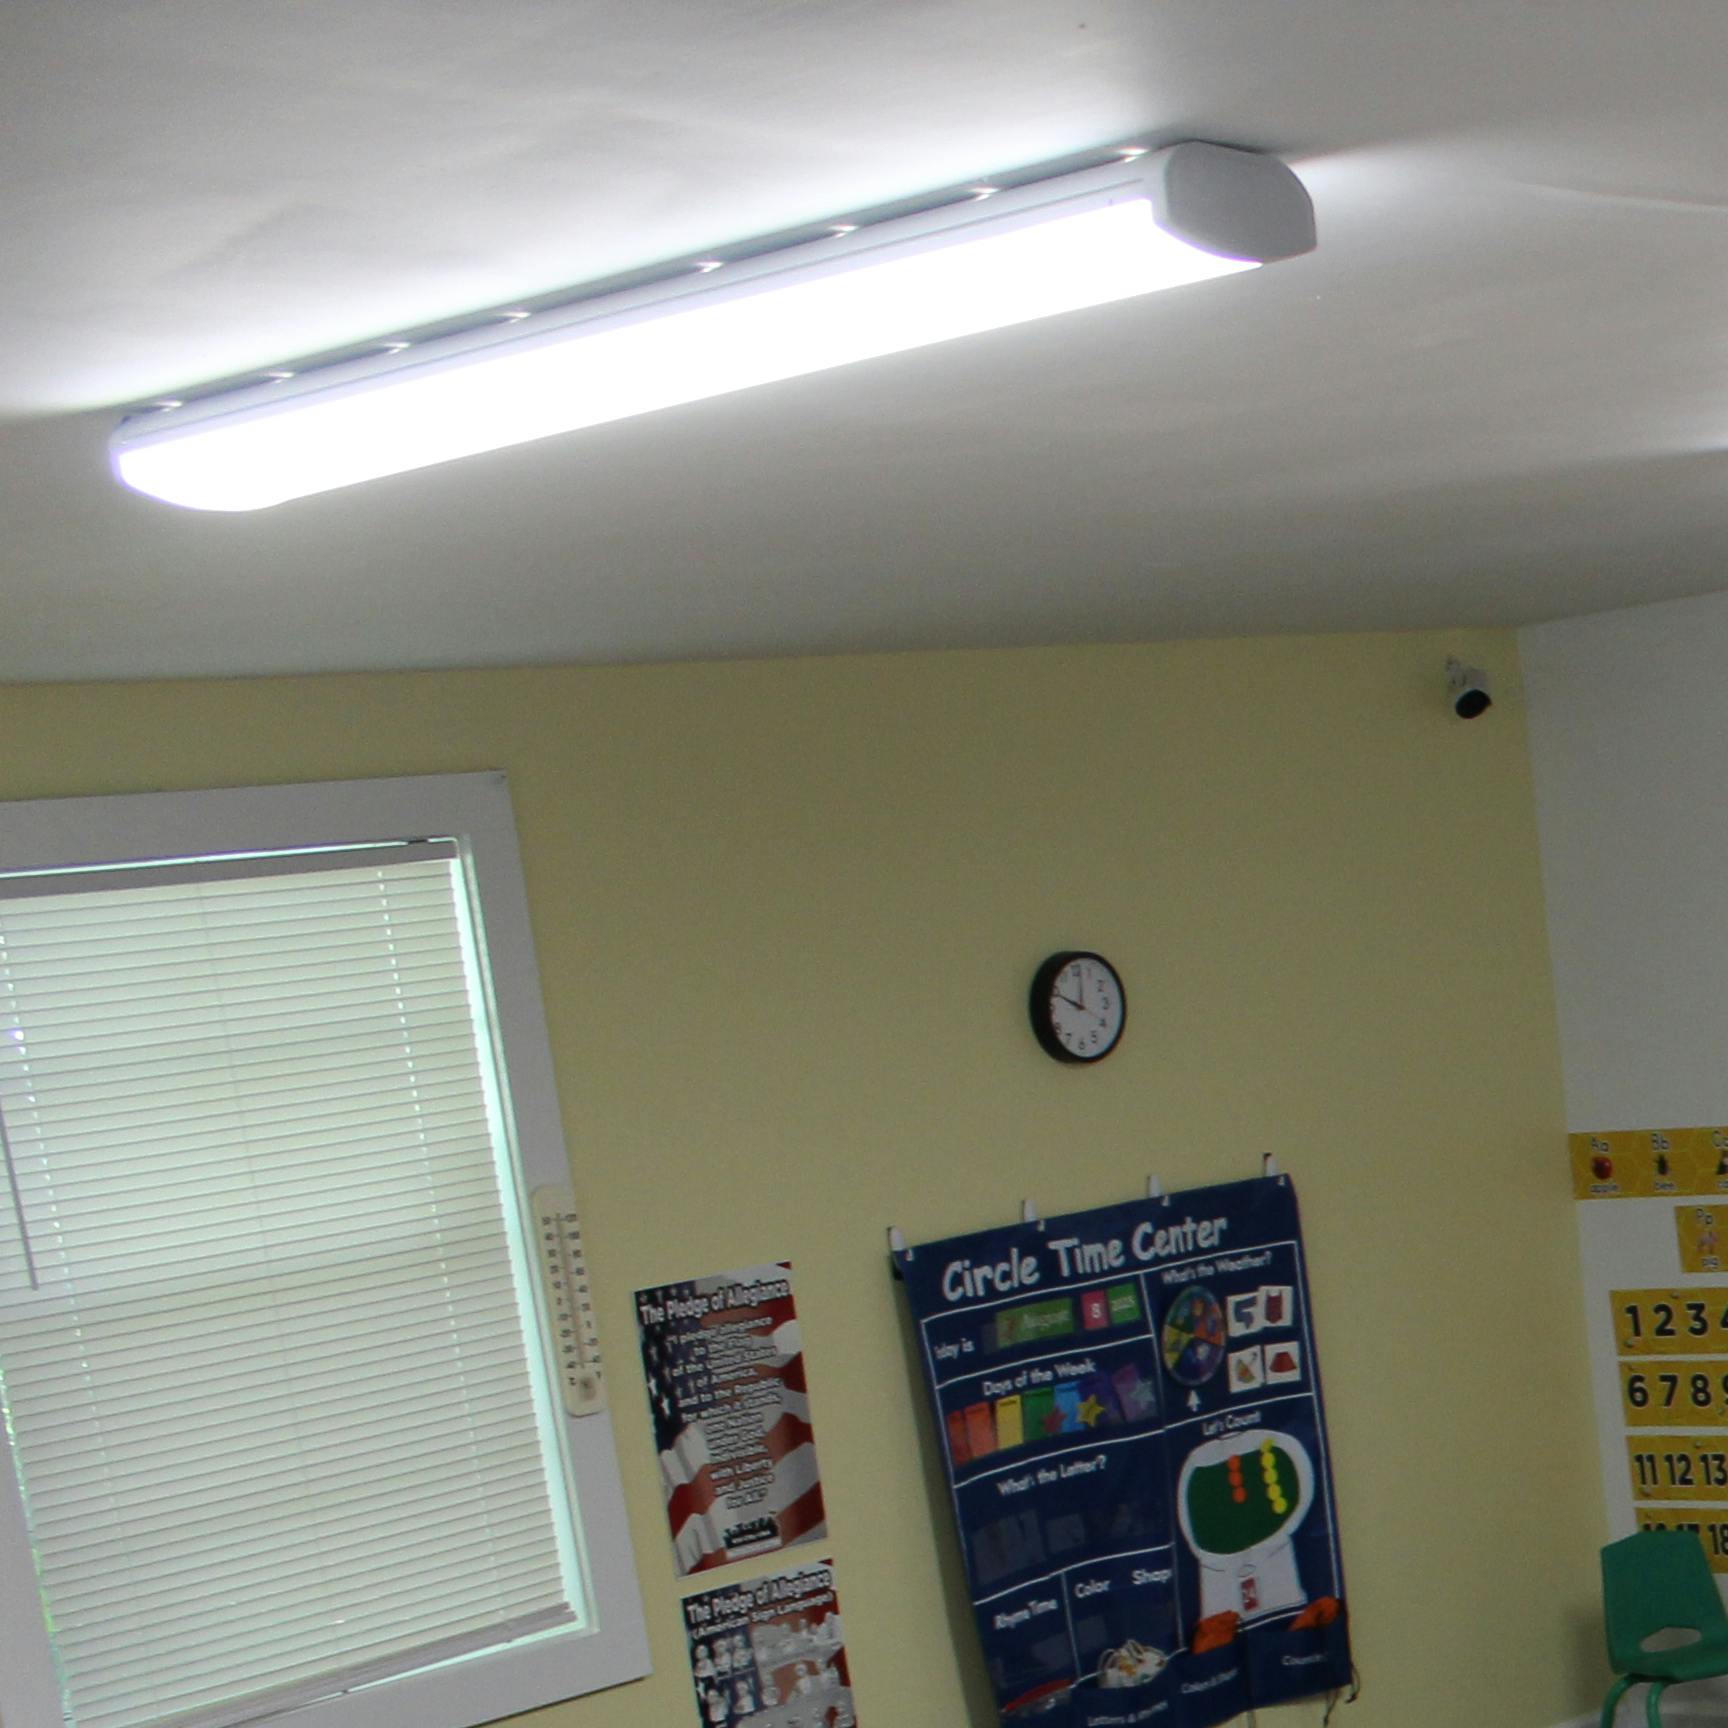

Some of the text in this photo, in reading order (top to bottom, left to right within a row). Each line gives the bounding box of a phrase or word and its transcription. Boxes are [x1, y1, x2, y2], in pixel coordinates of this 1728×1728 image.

[1591, 1137, 1610, 1153] Aa
[1650, 1135, 1669, 1151] Bb
[1589, 1182, 1620, 1195] apple
[1654, 1180, 1676, 1191] bee
[1697, 1209, 1714, 1227] Pp
[942, 1216, 1228, 1303] Circle Time Center
[1701, 1256, 1719, 1271] pig
[640, 1281, 791, 1325] The Pledge of Allegiance
[1625, 1305, 1642, 1338] 1
[1654, 1304, 1676, 1336] 2
[1686, 1302, 1709, 1336] 3
[983, 1358, 1097, 1396] Days of the Week
[1628, 1375, 1649, 1407] 6
[1658, 1374, 1679, 1407] 7
[1690, 1373, 1711, 1407] 8
[1225, 1410, 1262, 1430] Count
[996, 1454, 1107, 1496] What's the Letter?
[1634, 1454, 1659, 1486] 11
[1664, 1454, 1695, 1486] 12
[1699, 1454, 1728, 1486] 13
[686, 1571, 833, 1625] The Pledge of Allegiance
[1074, 1579, 1111, 1598] Color
[690, 1592, 835, 1638] (American Sign Language)
[1028, 1599, 1059, 1616] Time
